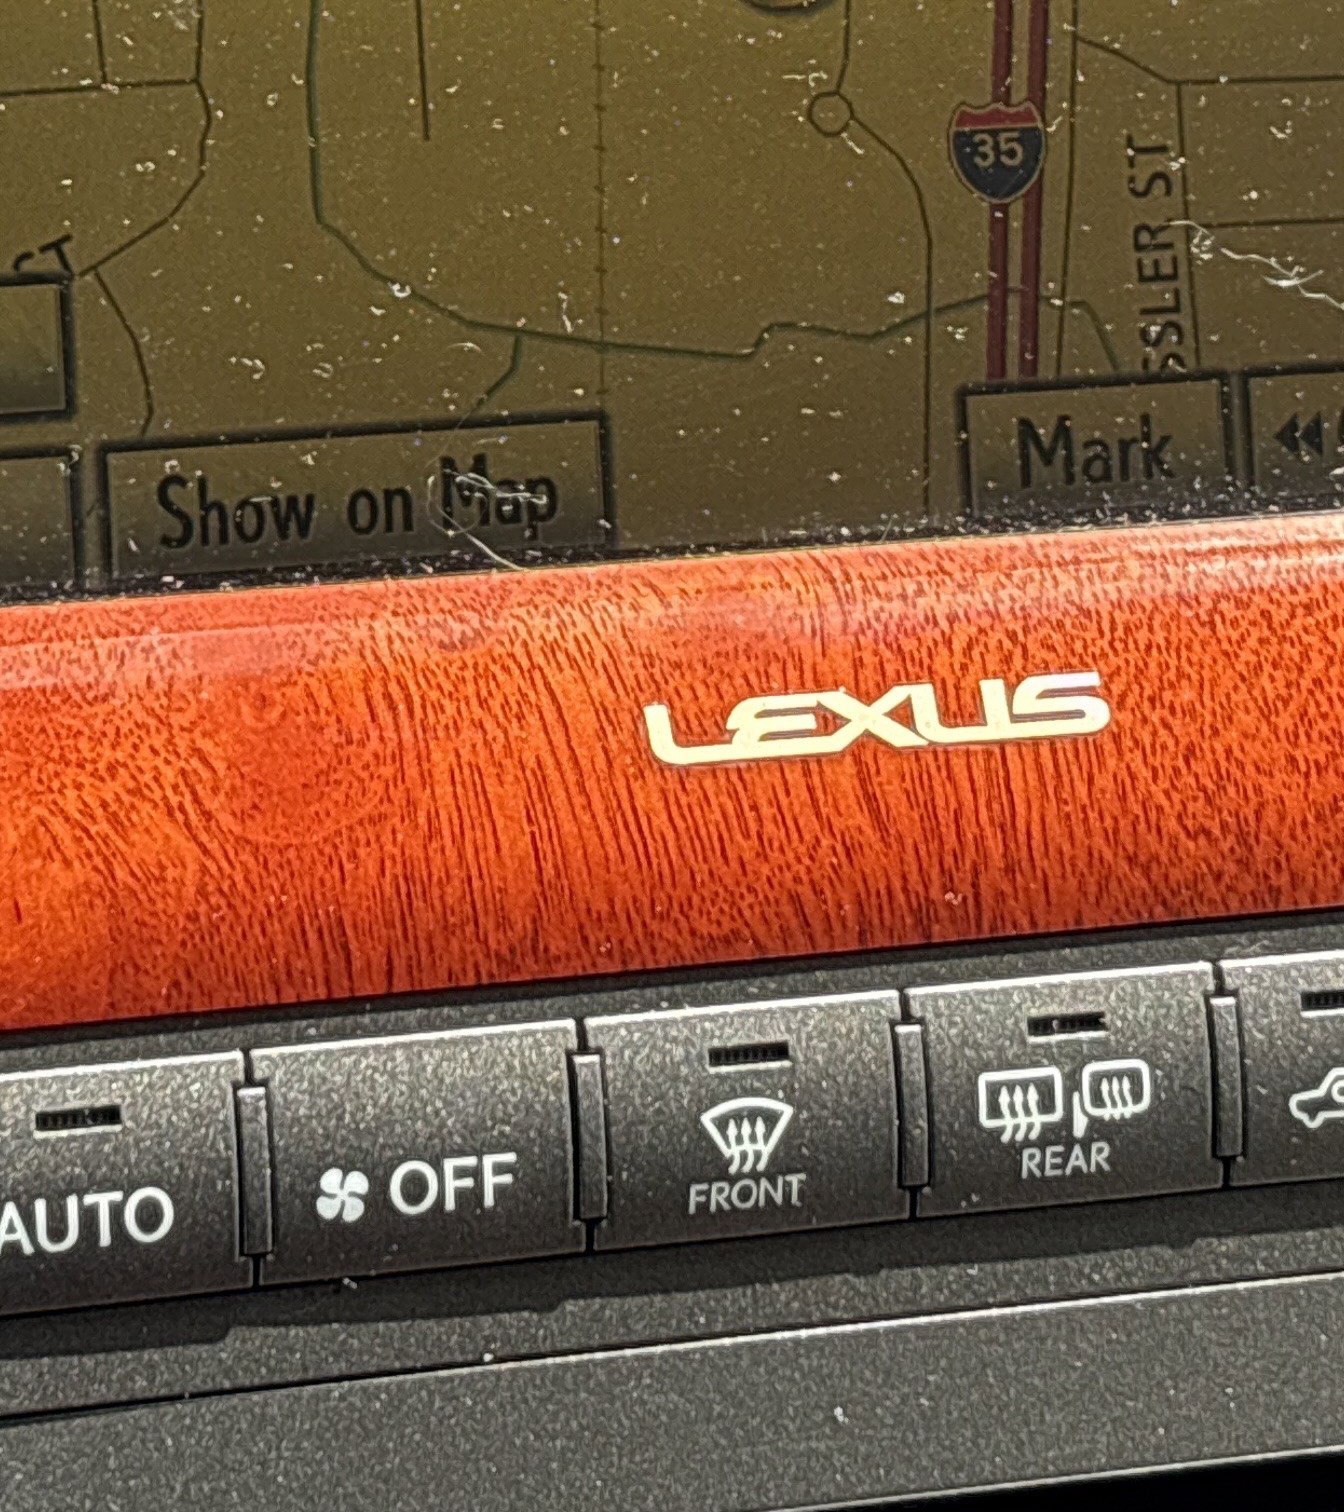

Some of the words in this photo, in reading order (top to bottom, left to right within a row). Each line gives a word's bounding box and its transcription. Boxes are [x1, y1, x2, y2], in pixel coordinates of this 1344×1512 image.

[972, 132, 1024, 169] 35
[1126, 134, 1174, 200] ST
[1017, 413, 1175, 489] Mark
[157, 474, 315, 549] Show
[347, 486, 414, 537] on
[439, 453, 557, 541] Map
[643, 670, 1110, 766] LEXUS
[389, 1151, 517, 1215] OFF
[1021, 1142, 1111, 1180] REAR
[687, 1172, 807, 1216] FRONT
